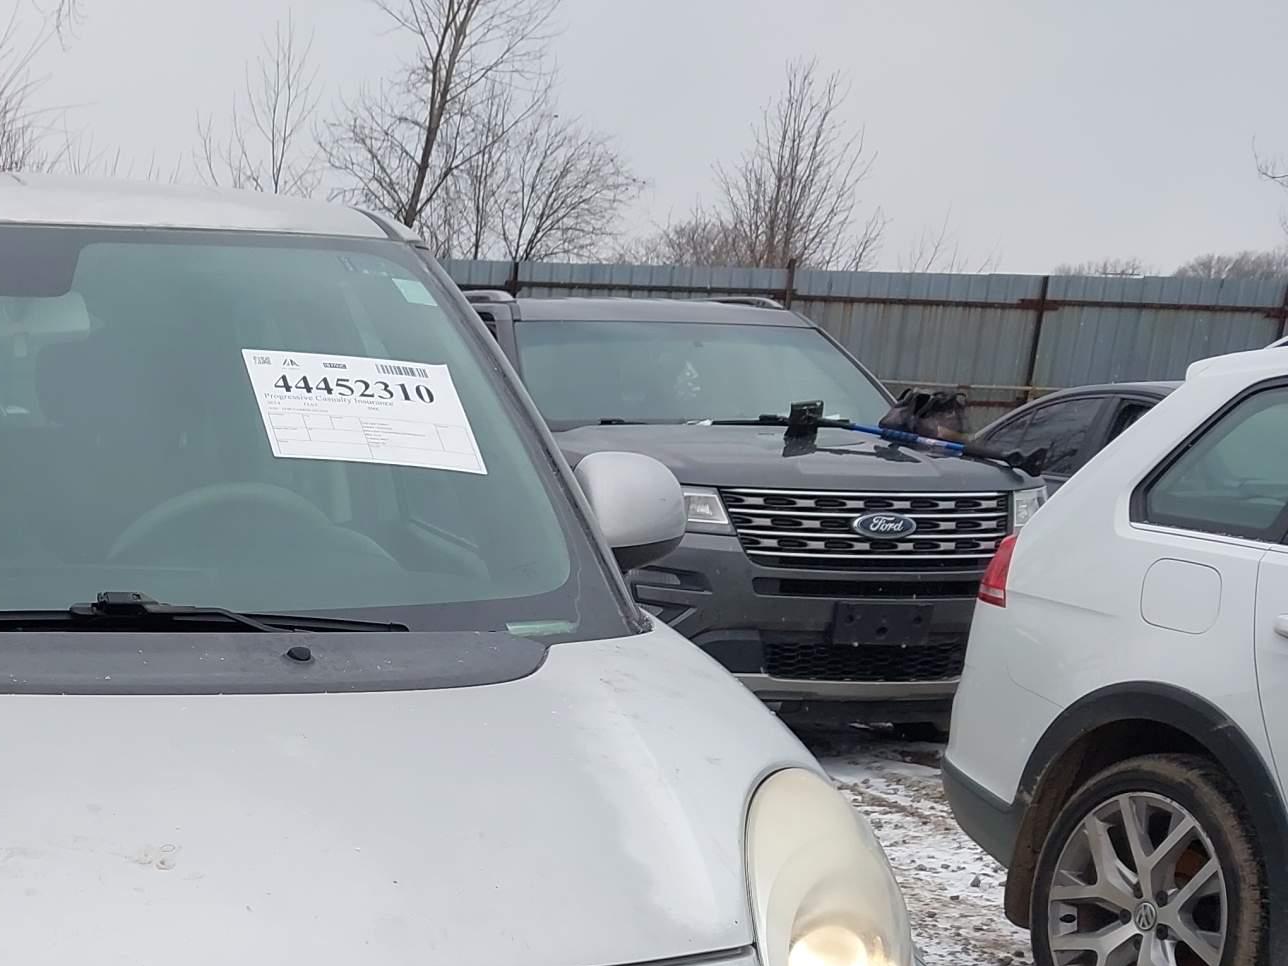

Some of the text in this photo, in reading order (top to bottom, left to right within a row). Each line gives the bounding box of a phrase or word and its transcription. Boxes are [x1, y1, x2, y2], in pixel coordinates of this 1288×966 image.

[274, 374, 435, 404] 44452310
[264, 393, 313, 401] Progressive
[315, 395, 352, 405] Casualty
[354, 398, 394, 407] Insurance
[869, 516, 904, 532] Ford
